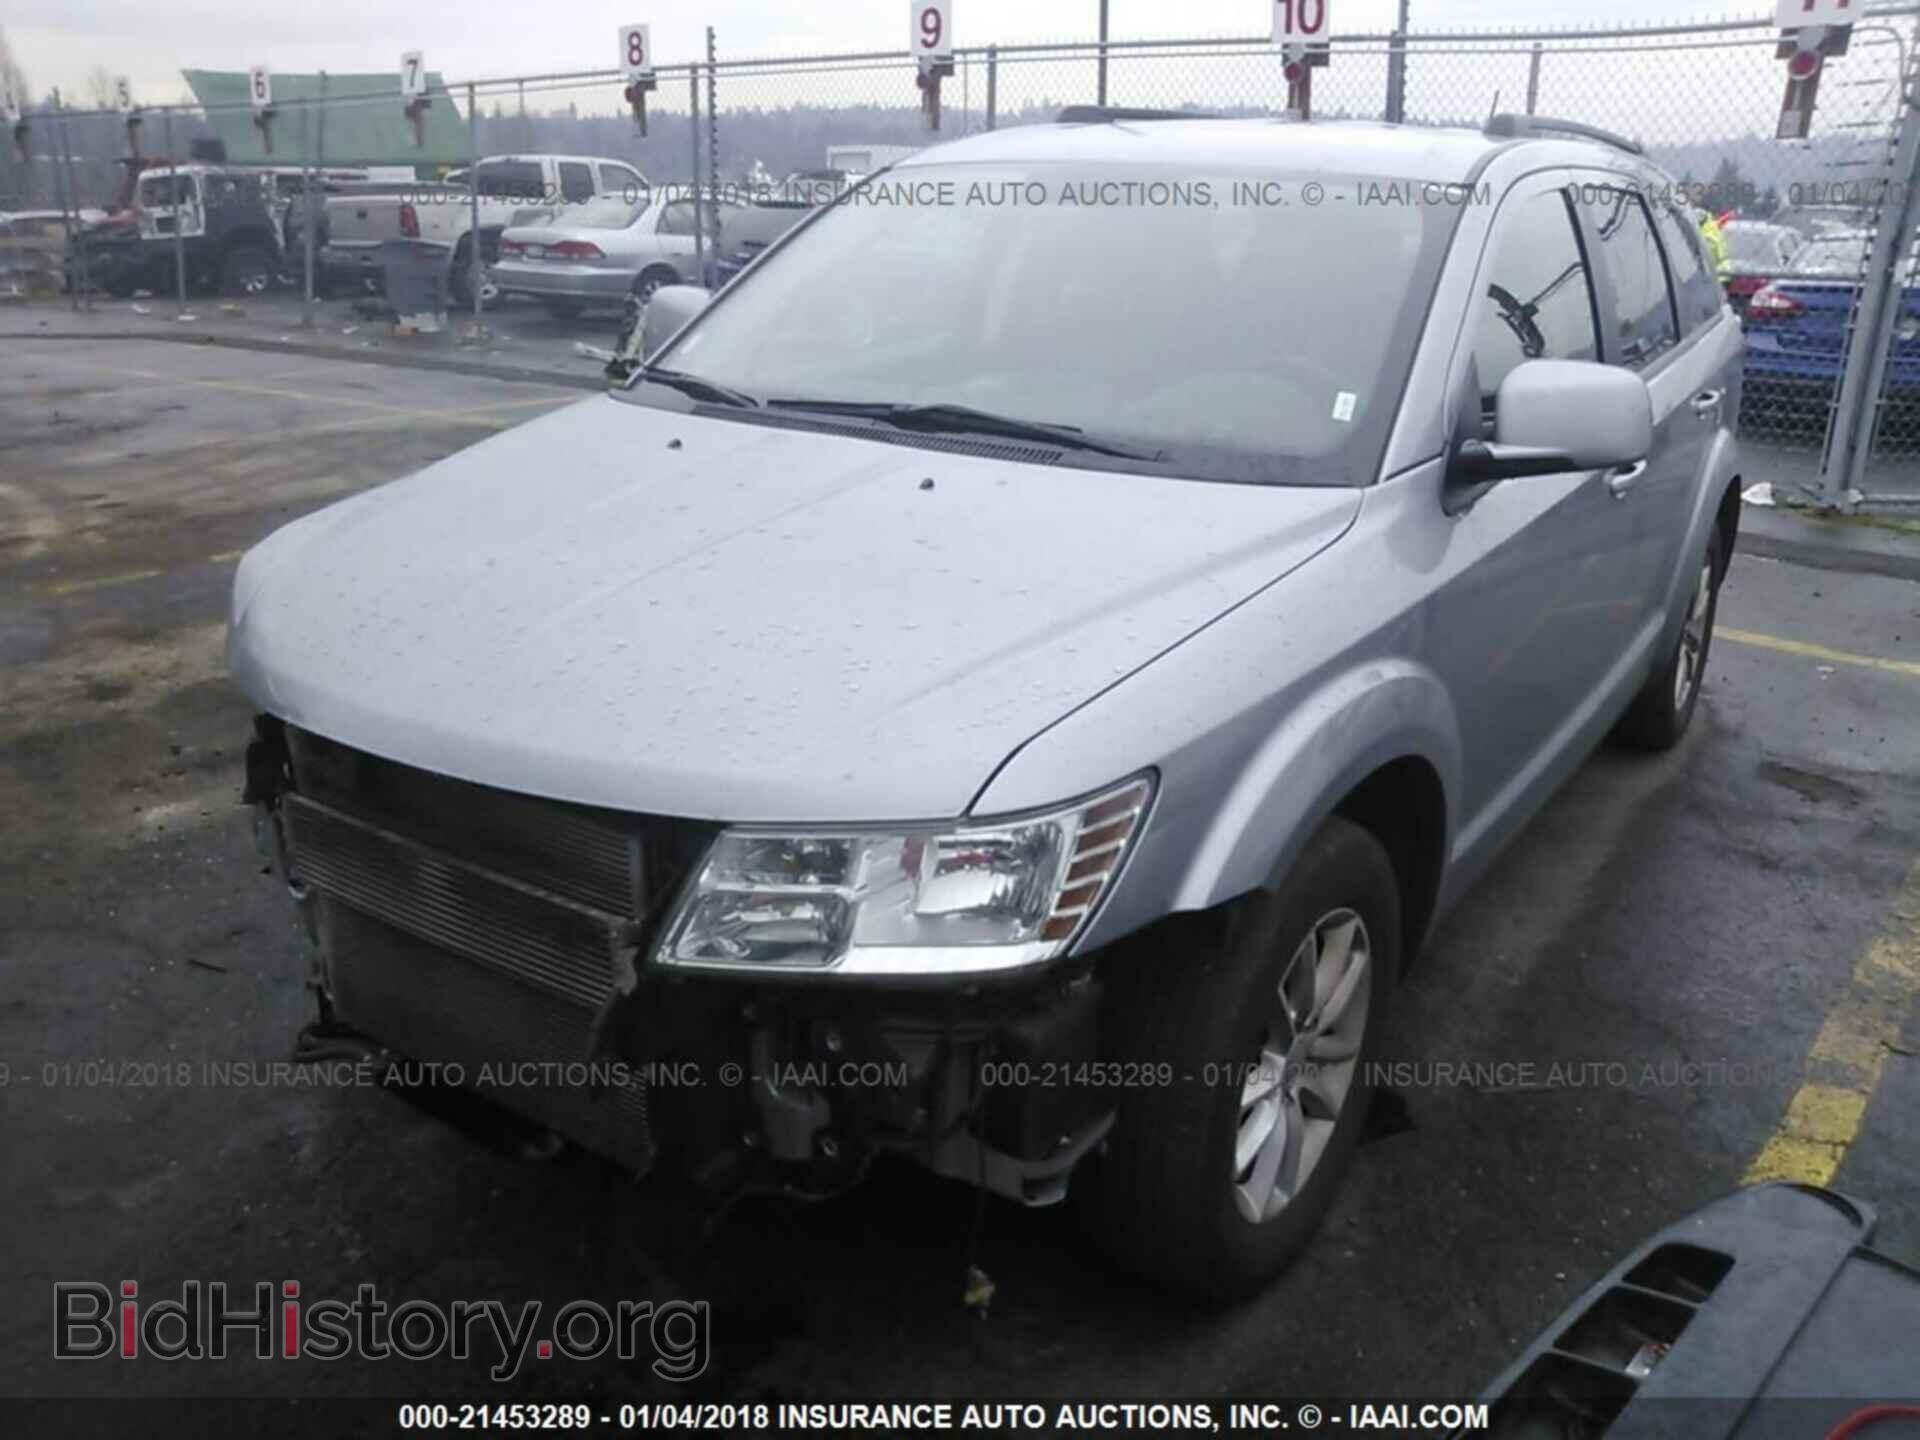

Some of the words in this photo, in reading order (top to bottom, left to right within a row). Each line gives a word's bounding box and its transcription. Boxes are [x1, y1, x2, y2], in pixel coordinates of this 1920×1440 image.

[921, 8, 942, 48] 9
[1277, 0, 1325, 34] 10
[627, 31, 643, 66] 8
[255, 72, 265, 99] 6
[407, 58, 418, 89] 7
